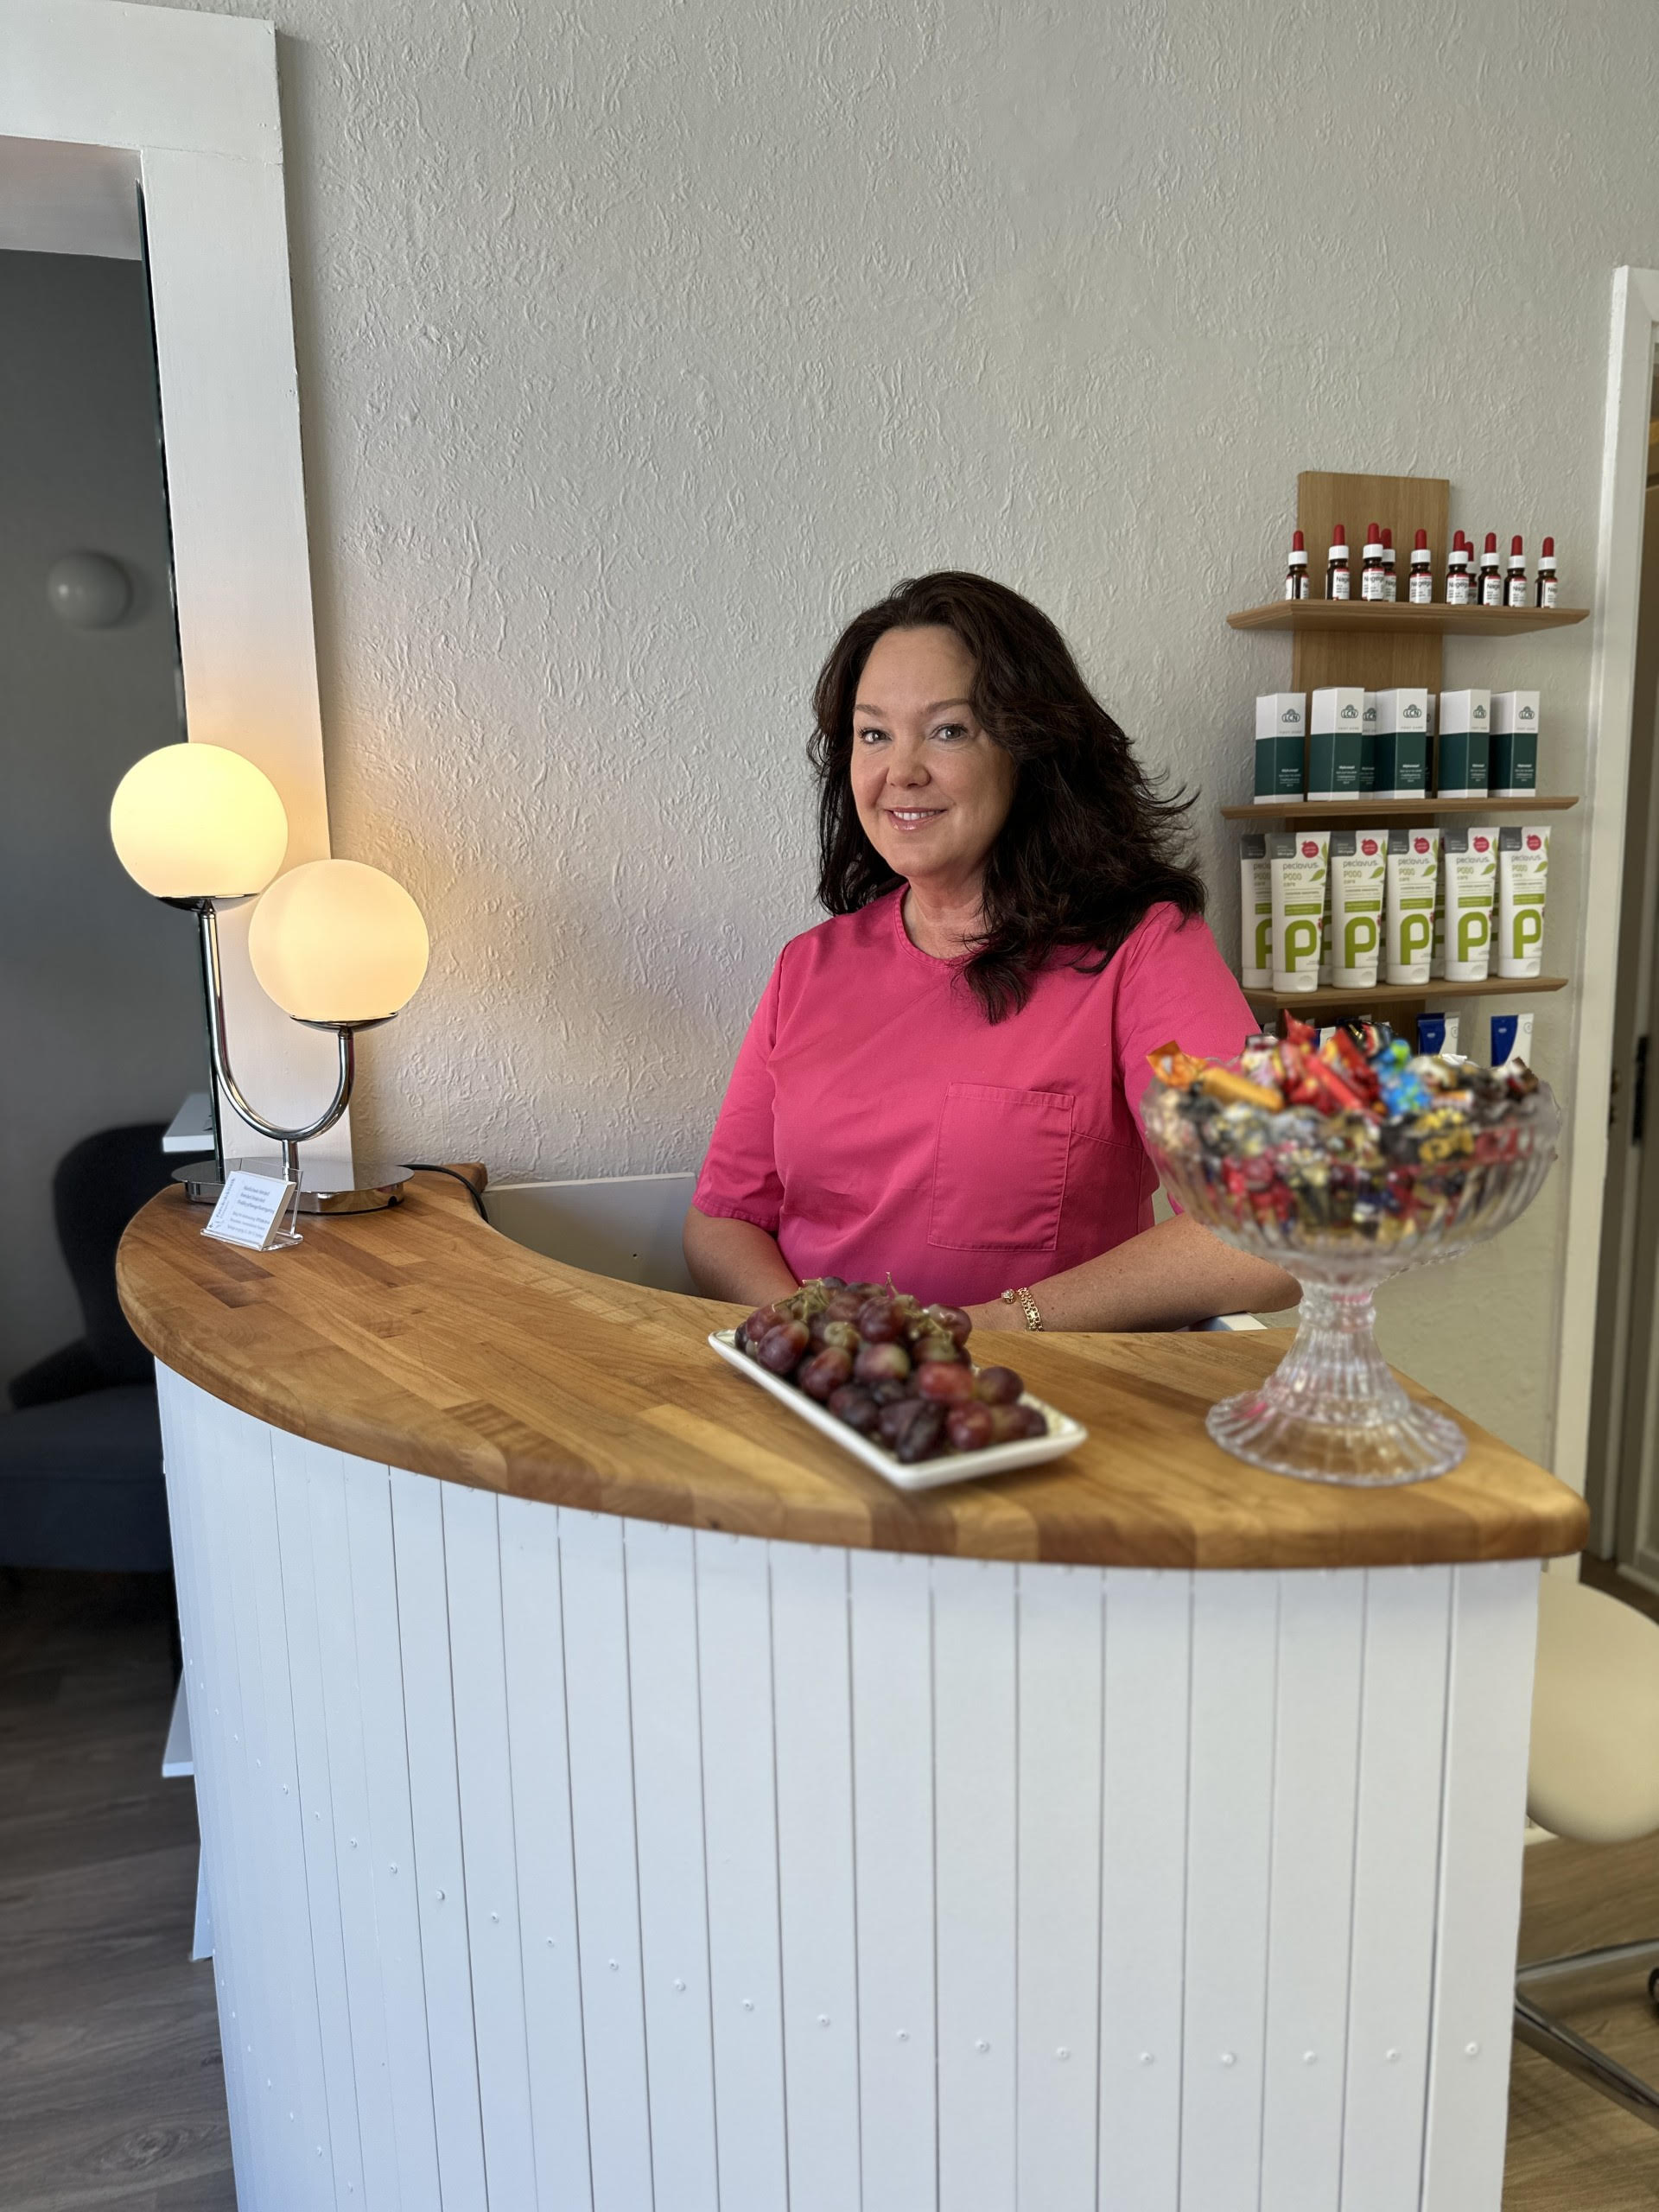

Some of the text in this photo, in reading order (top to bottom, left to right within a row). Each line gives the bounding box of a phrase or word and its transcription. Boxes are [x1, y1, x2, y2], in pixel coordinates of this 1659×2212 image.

[1284, 714, 1298, 722] LCN
[1343, 709, 1356, 718] LCN
[1406, 709, 1419, 718] LCN
[1343, 859, 1376, 868] peclavus
[1398, 857, 1428, 866] peclavus
[1456, 856, 1488, 865] peclavus
[1511, 855, 1541, 863] peclavus
[1283, 862, 1318, 871] peclavus
[1458, 912, 1488, 963] P
[1513, 909, 1541, 959] P
[1344, 916, 1376, 969] P
[1400, 913, 1430, 965] P
[1285, 919, 1317, 973] P
